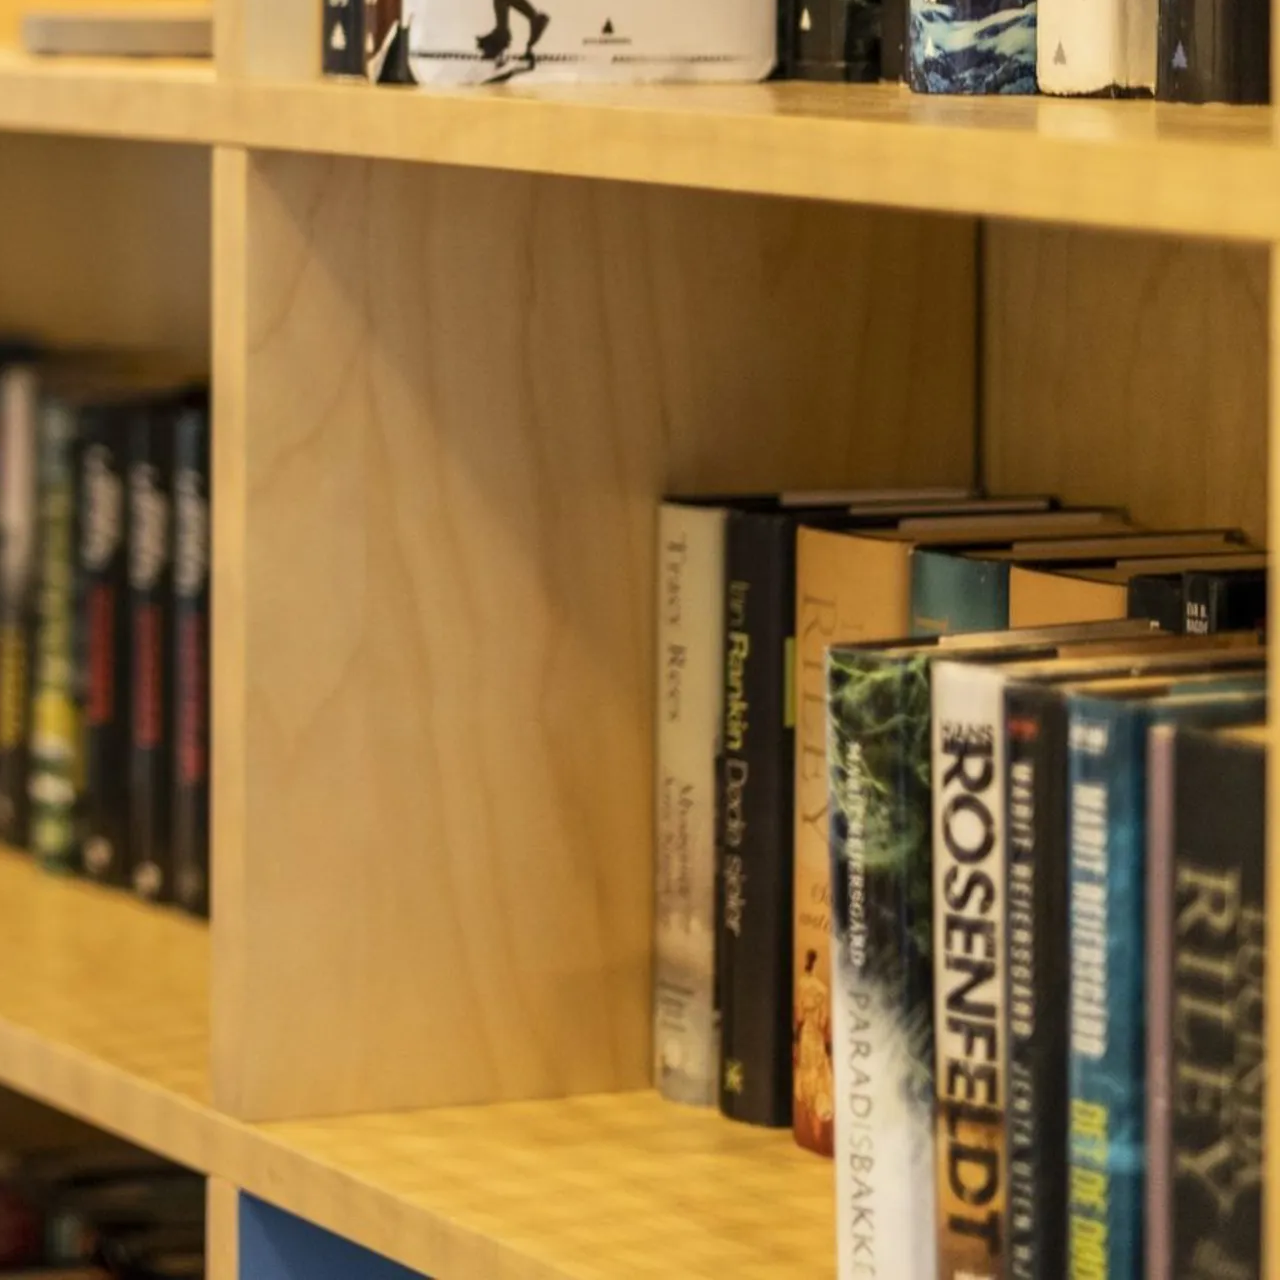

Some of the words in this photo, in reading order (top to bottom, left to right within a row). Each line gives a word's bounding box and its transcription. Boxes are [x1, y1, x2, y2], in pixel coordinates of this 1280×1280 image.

[726, 631, 751, 751] Rankin
[942, 736, 1002, 1253] ROSENFELDT
[1177, 863, 1237, 1215] RILEY
